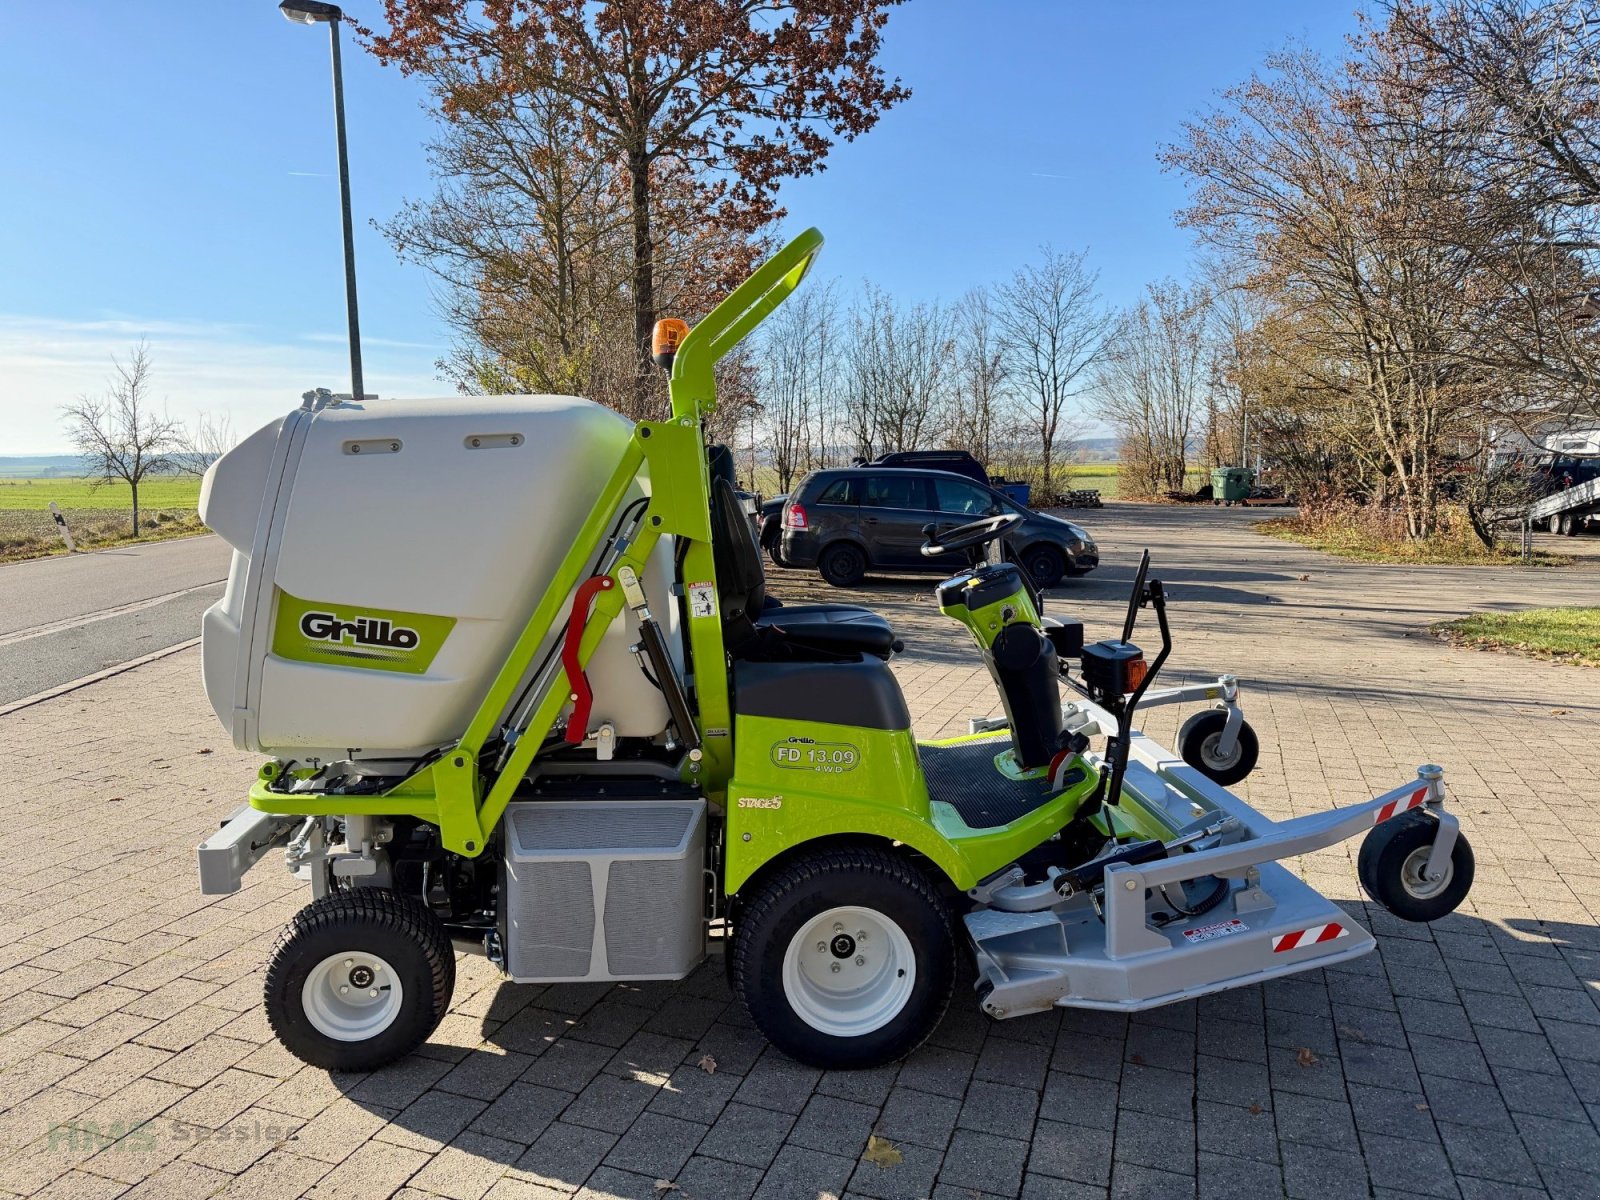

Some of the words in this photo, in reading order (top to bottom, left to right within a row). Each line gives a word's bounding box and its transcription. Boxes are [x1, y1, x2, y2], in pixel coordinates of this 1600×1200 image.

[301, 611, 419, 650] Grillo
[778, 748, 801, 762] FD
[807, 750, 854, 764] 13.09
